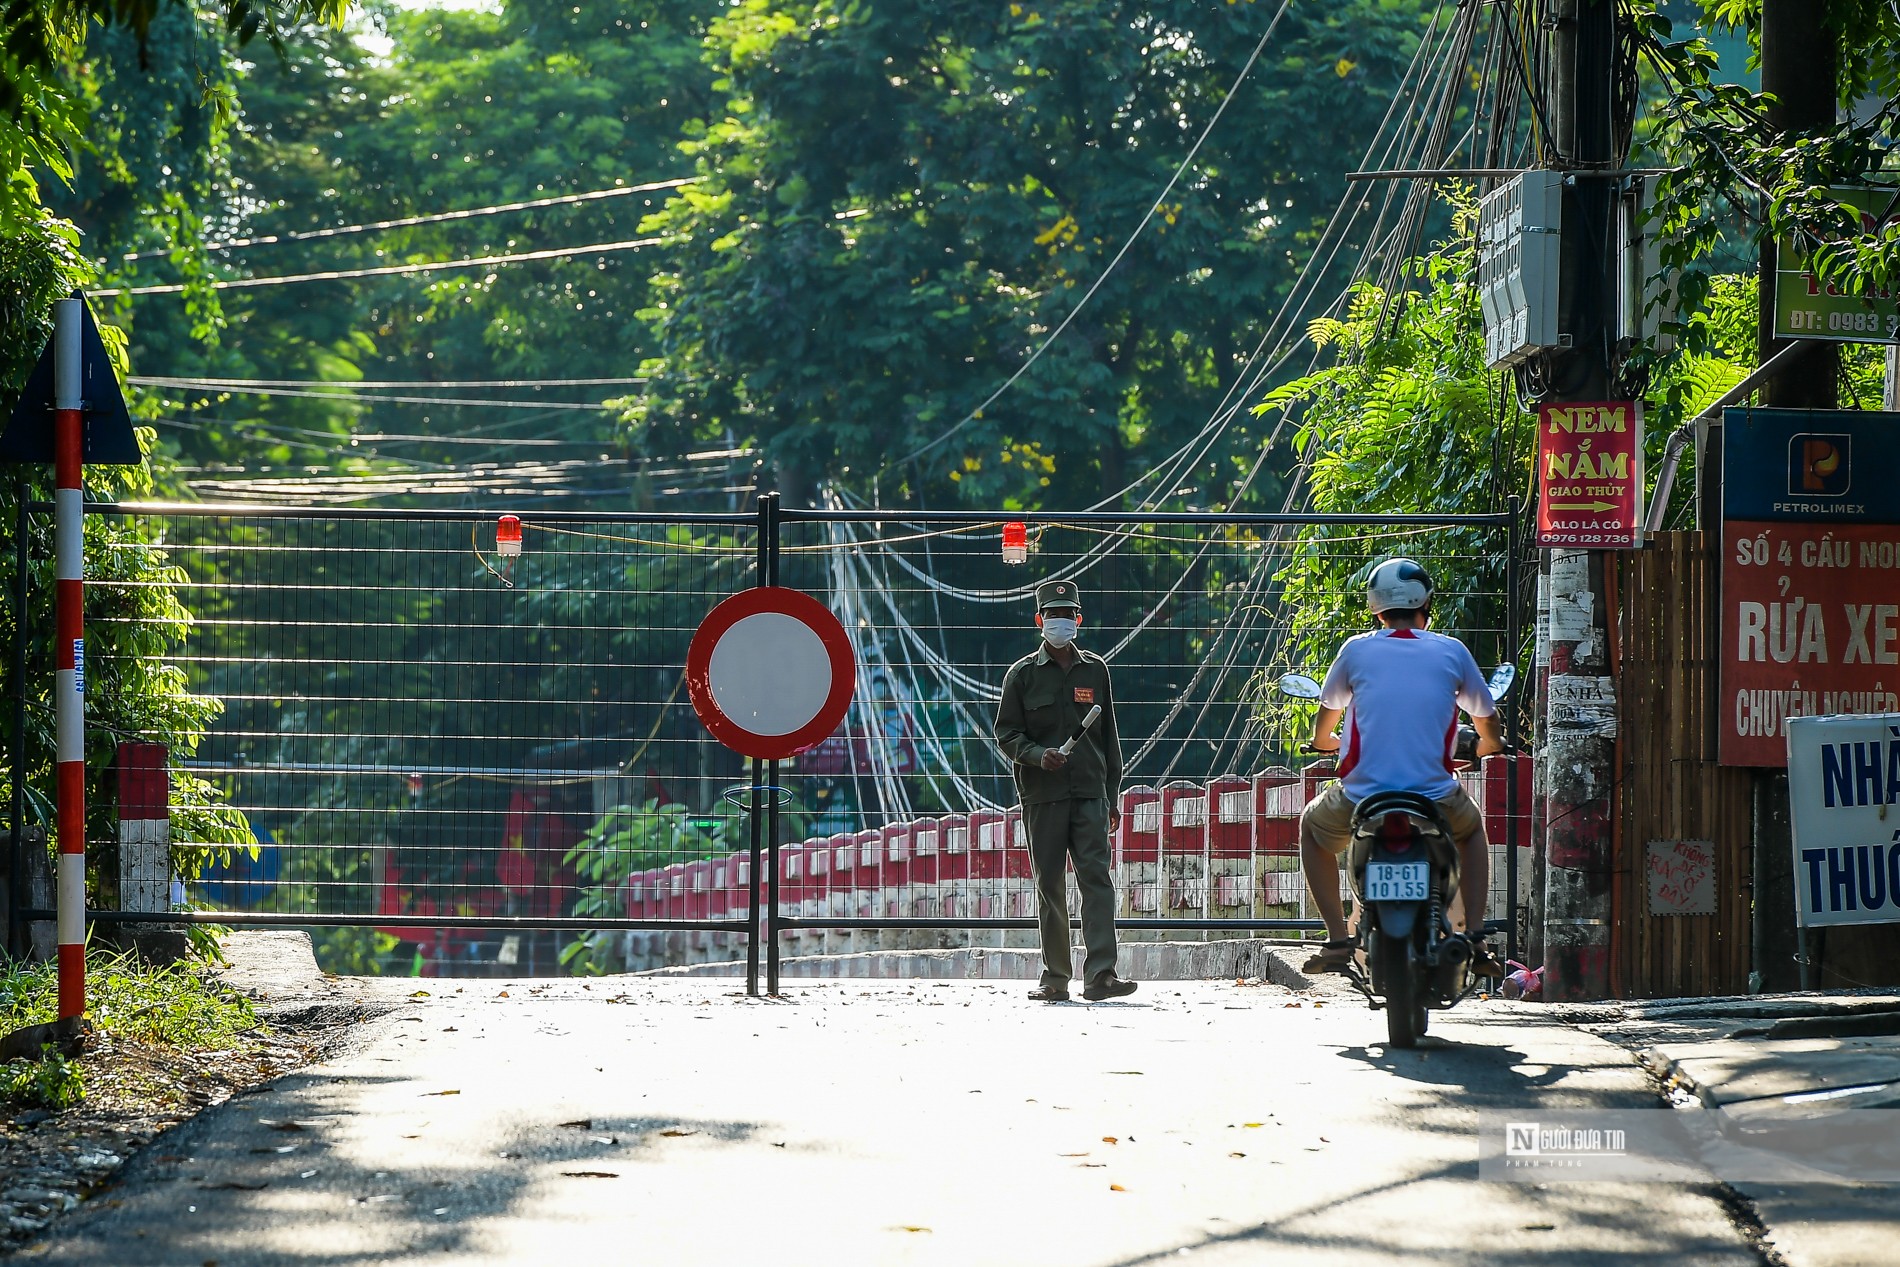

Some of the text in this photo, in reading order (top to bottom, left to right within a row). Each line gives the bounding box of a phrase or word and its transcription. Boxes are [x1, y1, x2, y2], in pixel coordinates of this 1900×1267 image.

[1791, 310, 1822, 330] ĐT:
[1828, 311, 1879, 332] 0983
[1547, 407, 1627, 433] NEM
[1545, 438, 1628, 480] NẮM
[1549, 482, 1626, 496] GIAO THỦY
[1773, 502, 1865, 514] PETROLIMEX
[1551, 518, 1621, 530] ALO LÀ CÓ
[1541, 534, 1630, 544] 0976 128 736
[1736, 529, 1771, 566] SỐ
[1777, 540, 1793, 566] 4
[1801, 531, 1851, 567] CẦU
[1738, 575, 1899, 665] RỬA XE
[1377, 865, 1418, 881] 18-G1
[1371, 882, 1425, 898] 101.55
